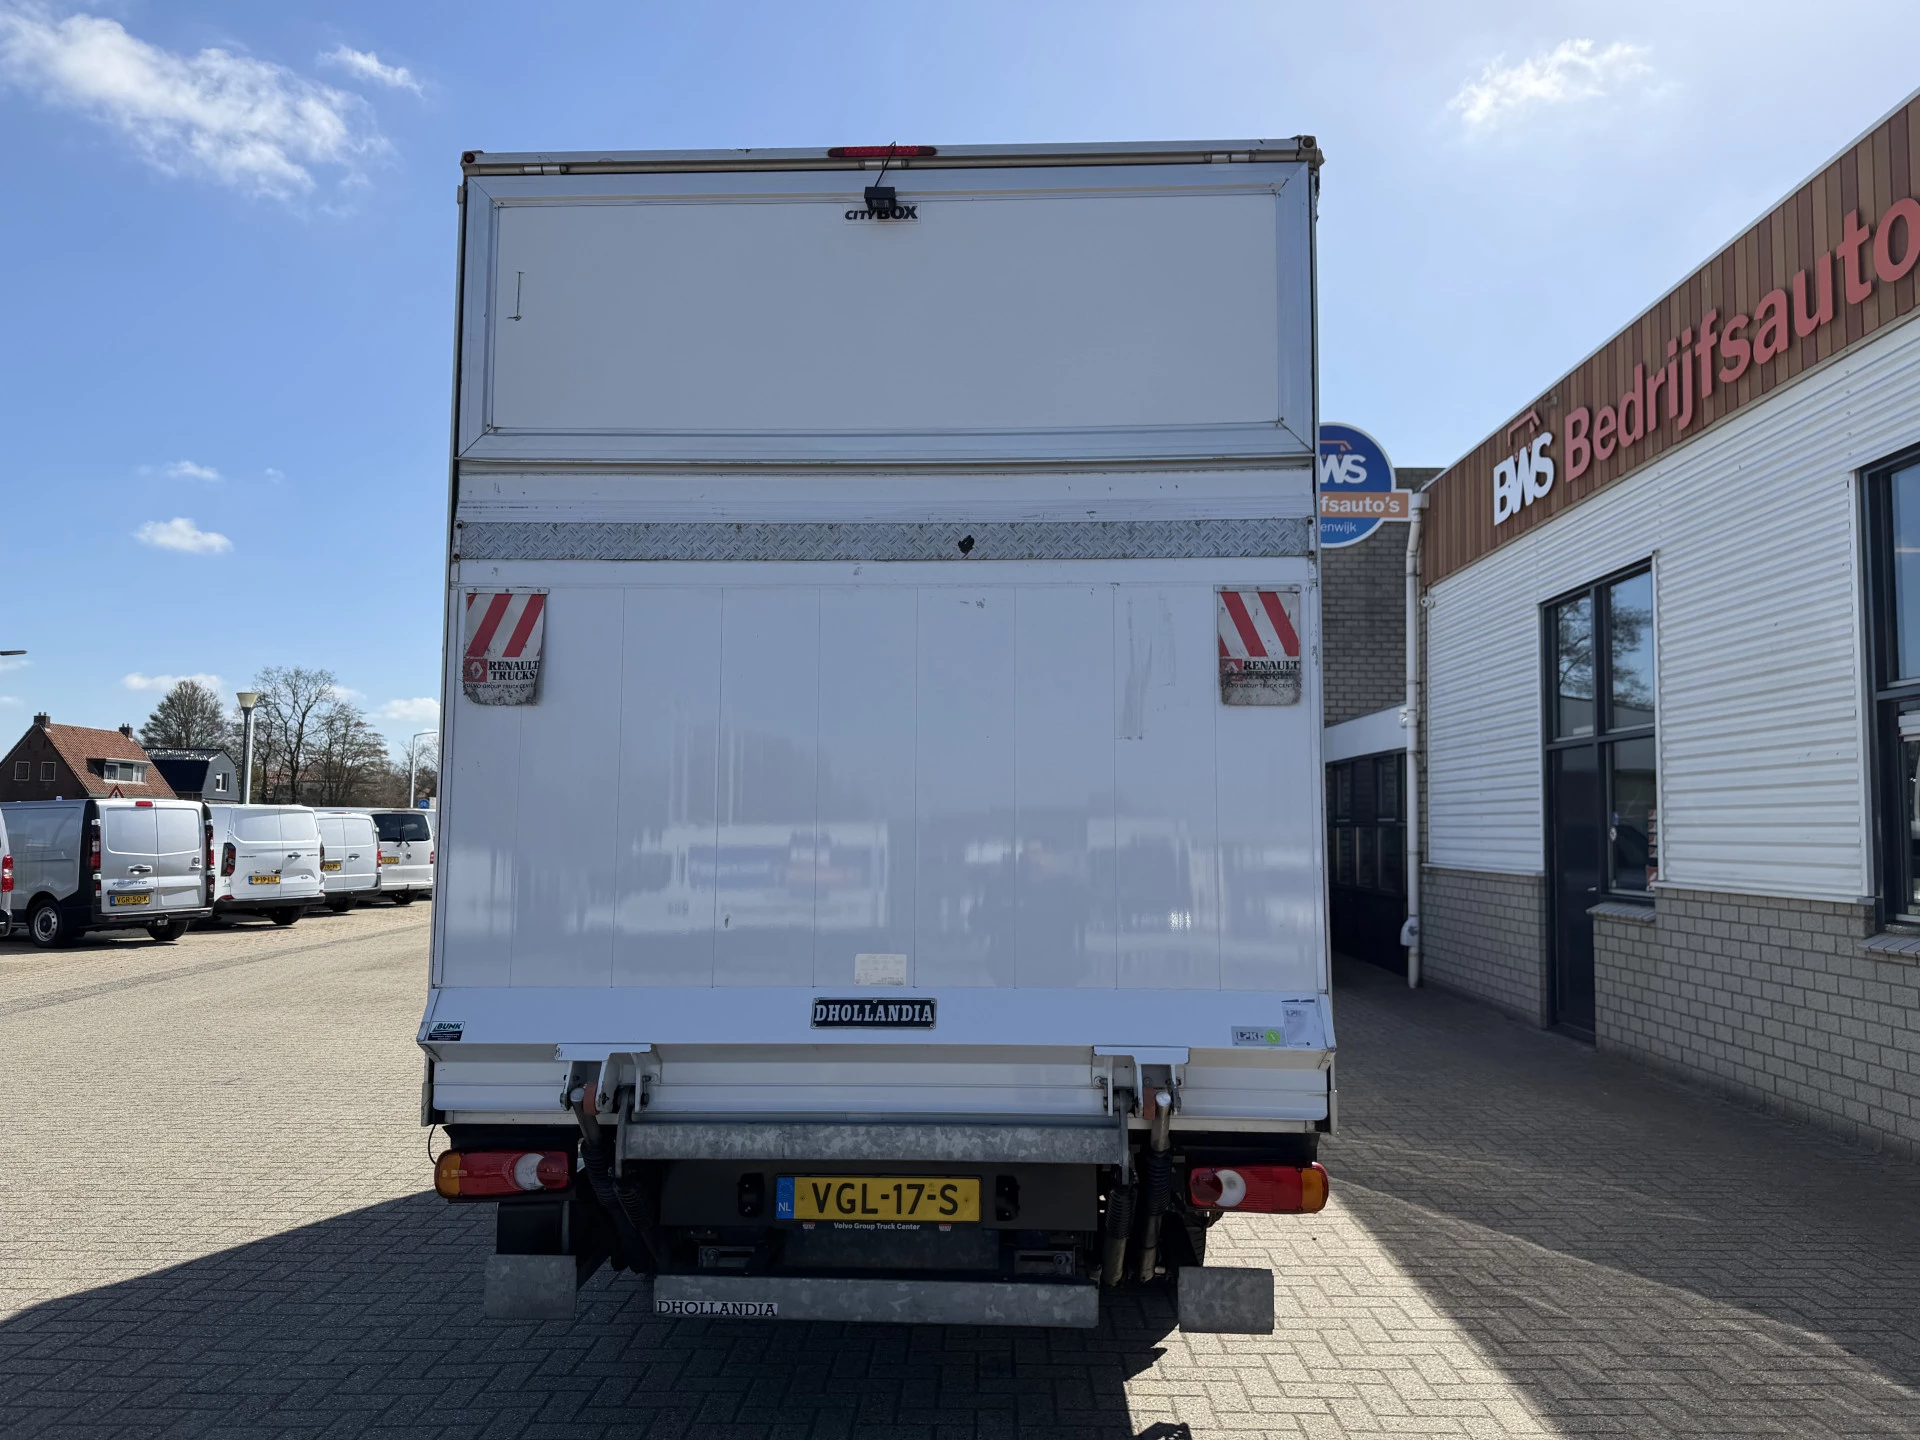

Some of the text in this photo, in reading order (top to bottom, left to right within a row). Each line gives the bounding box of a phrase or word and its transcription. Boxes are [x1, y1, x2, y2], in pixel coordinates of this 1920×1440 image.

[1320, 453, 1367, 485] WS
[1493, 432, 1555, 526] BWS
[1320, 496, 1400, 513] fsauto's
[1320, 521, 1357, 535] enwijk
[488, 660, 540, 671] RENAULT
[1243, 660, 1300, 671] RENAULT
[490, 670, 535, 681] TRUCKS
[814, 1004, 933, 1022] DHOLLANDIA
[778, 1182, 959, 1216] NL VGL-17-S
[853, 1222, 875, 1231] Group
[876, 1222, 896, 1230] Truck
[657, 1300, 776, 1317] DHOLLANDIA
